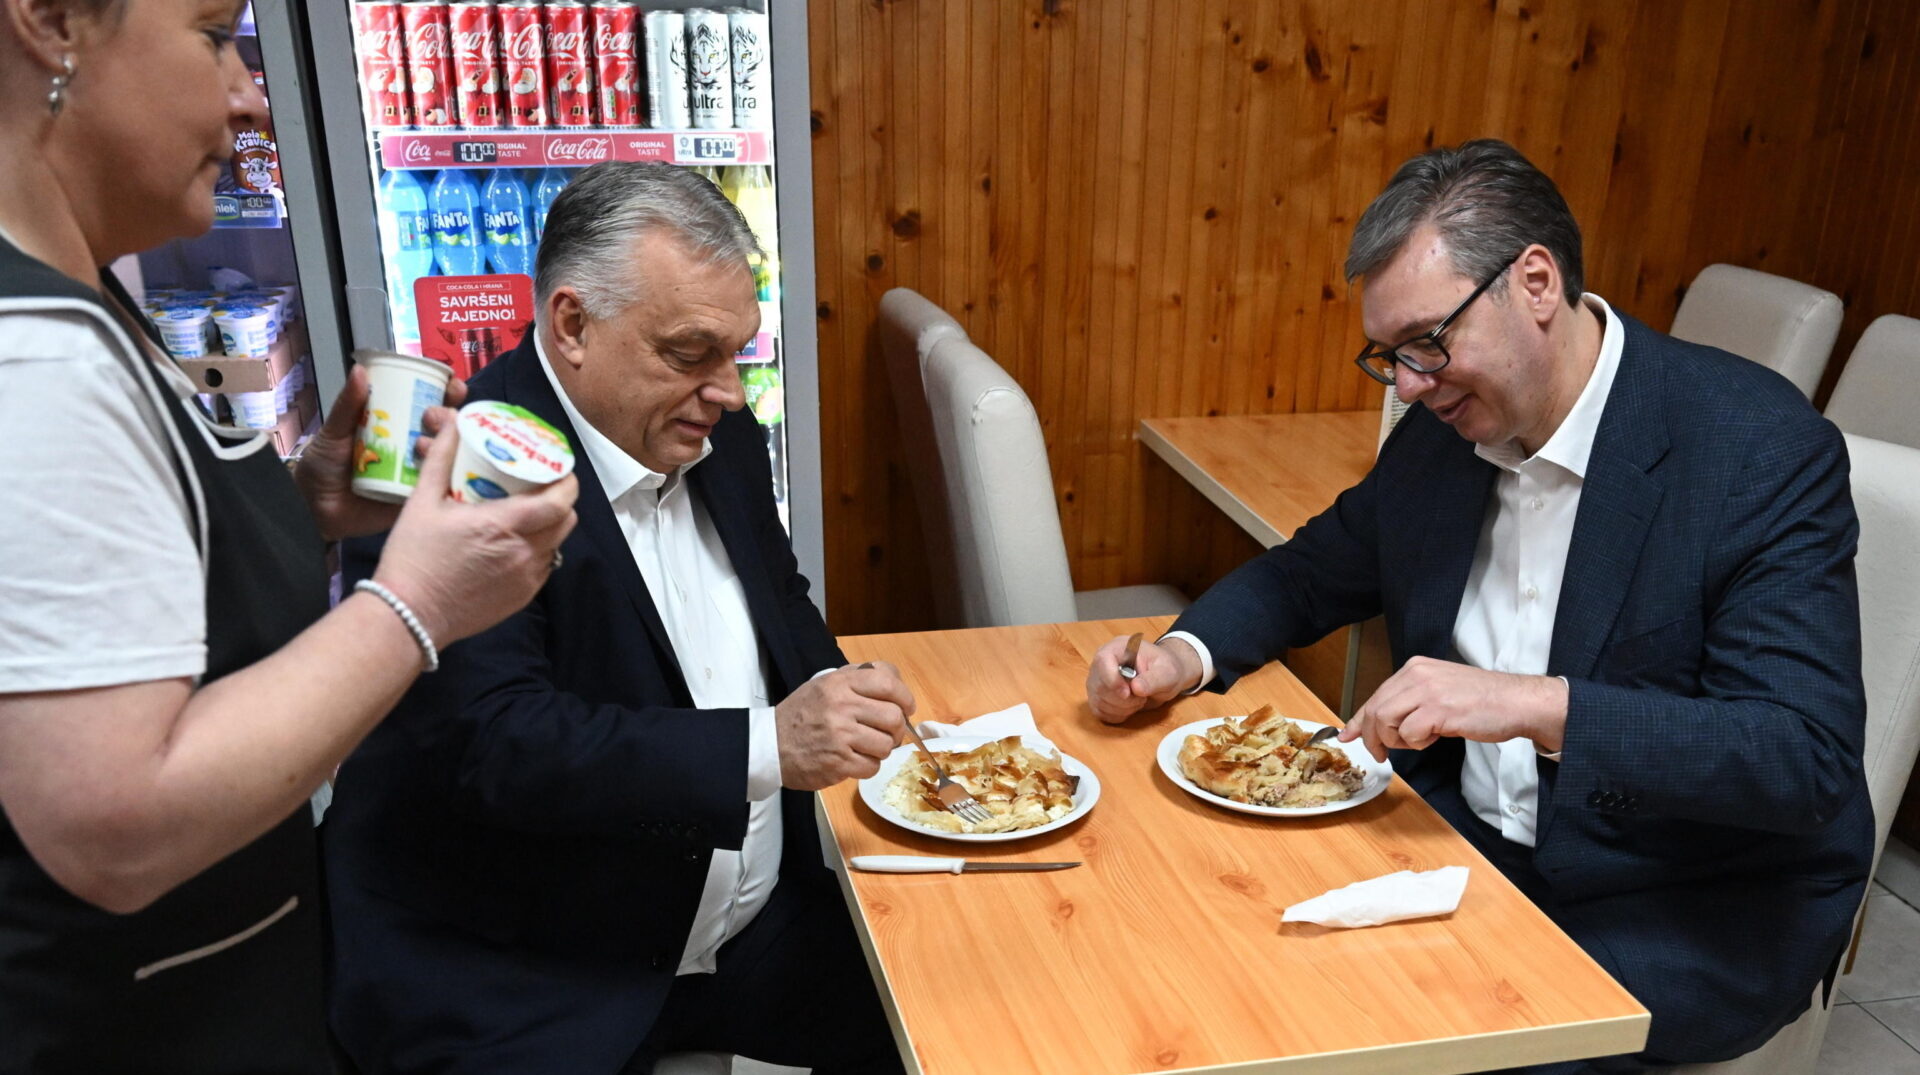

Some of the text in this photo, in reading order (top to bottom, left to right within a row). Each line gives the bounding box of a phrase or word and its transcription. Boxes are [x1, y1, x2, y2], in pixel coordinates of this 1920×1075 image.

[694, 94, 725, 109] ultra
[234, 138, 277, 152] Kravica
[547, 137, 609, 160] Coca-Cola
[629, 141, 666, 149] ORIGINAL
[432, 211, 471, 228] FANTA
[484, 211, 521, 228] FANTA
[439, 292, 514, 308] SAVRŠENI
[440, 308, 516, 324] ZAJEDNO!
